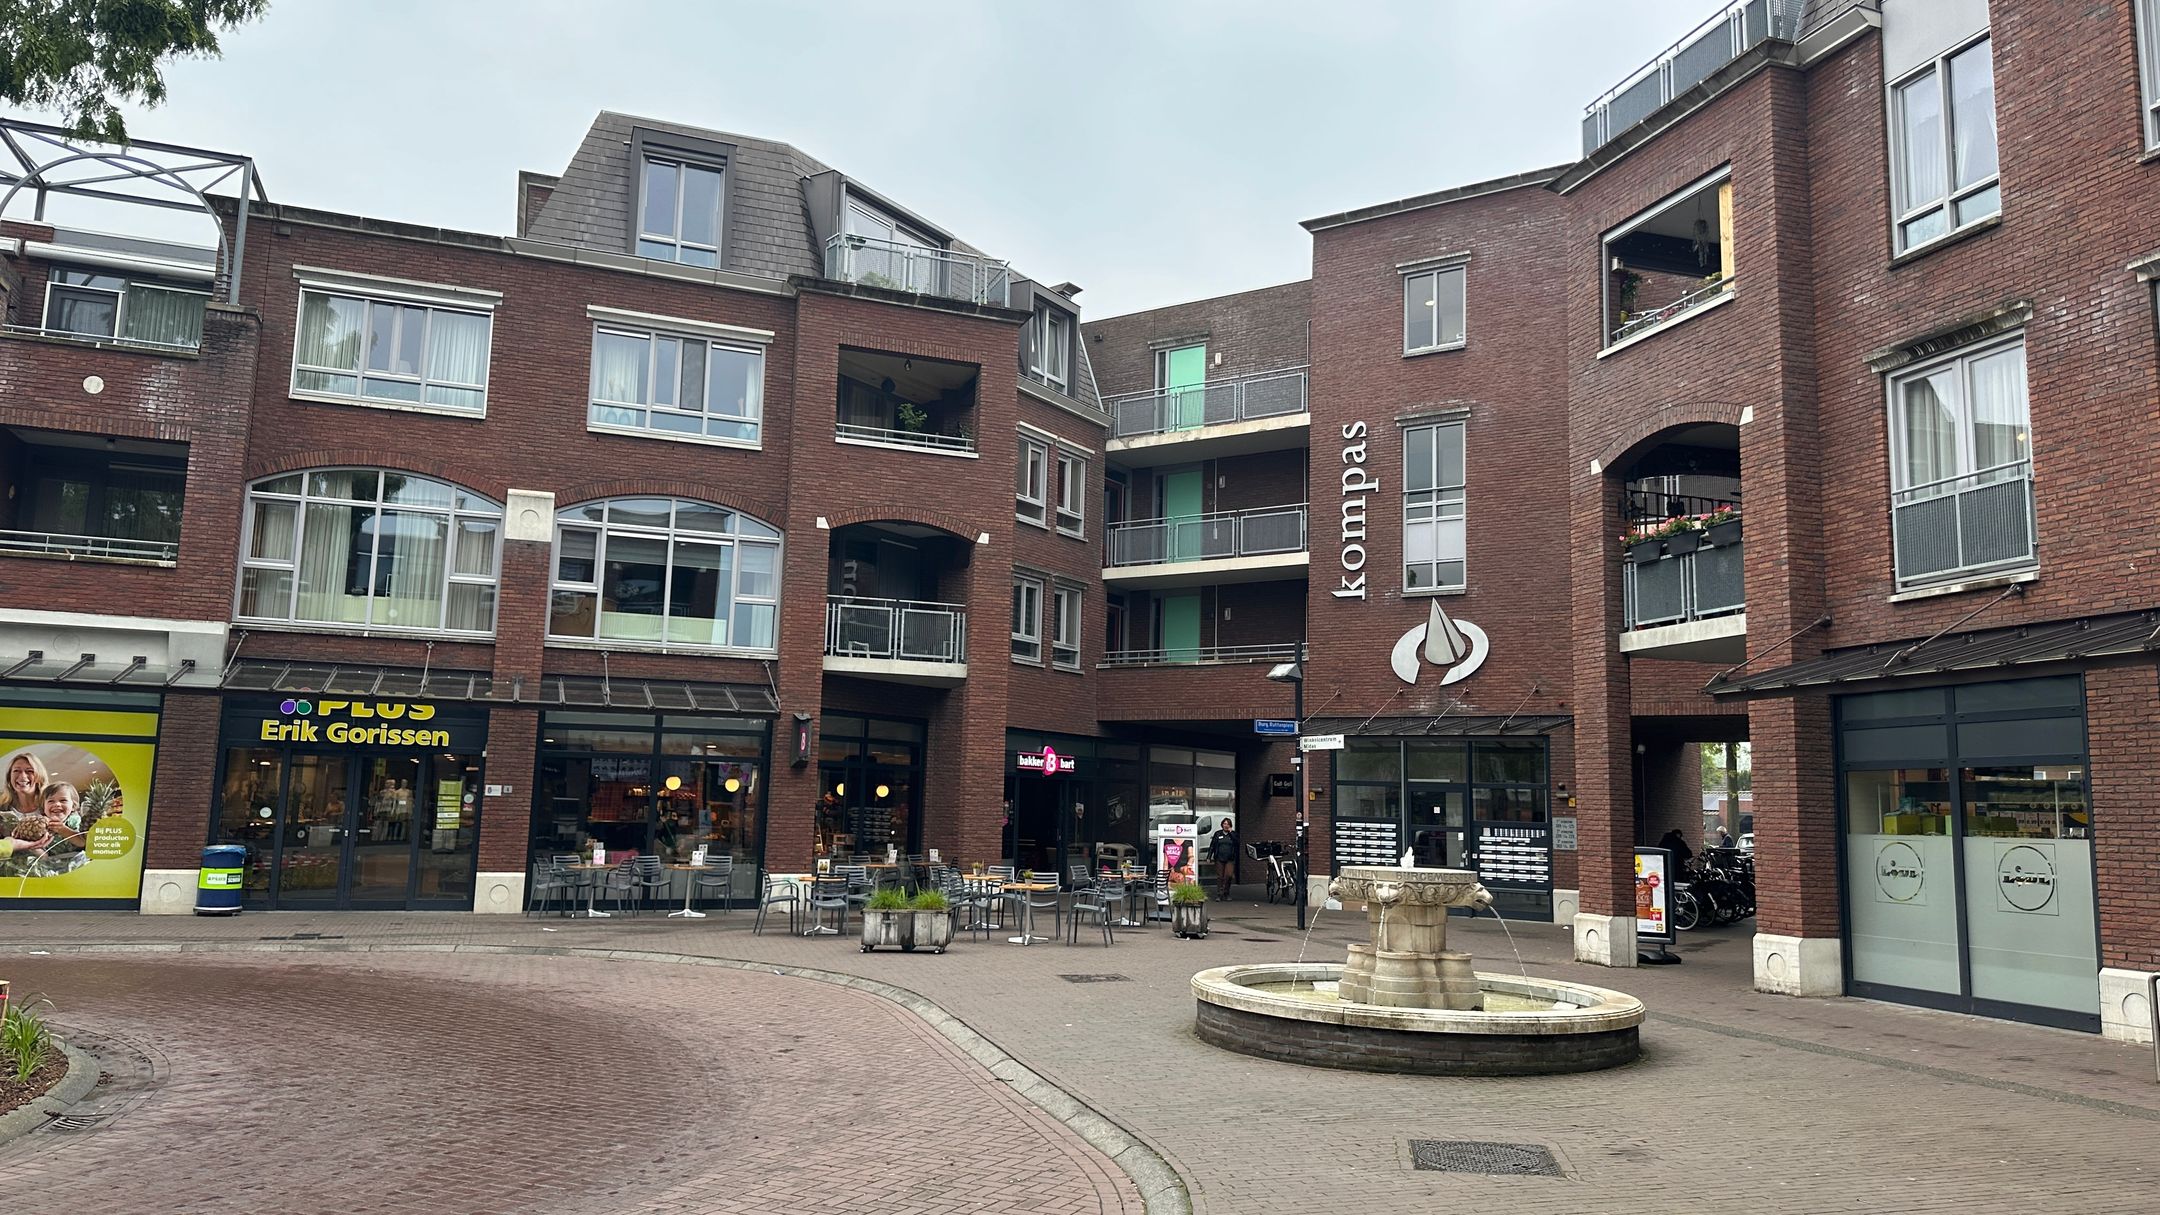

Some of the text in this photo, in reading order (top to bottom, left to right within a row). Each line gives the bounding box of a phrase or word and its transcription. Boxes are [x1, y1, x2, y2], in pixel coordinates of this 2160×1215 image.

[1331, 420, 1380, 601] kompas
[260, 719, 450, 747] Erik Gorissen
[1019, 755, 1044, 767] bakker
[1060, 758, 1075, 769] bart
[94, 834, 129, 842] producten
[95, 827, 104, 835] Bij
